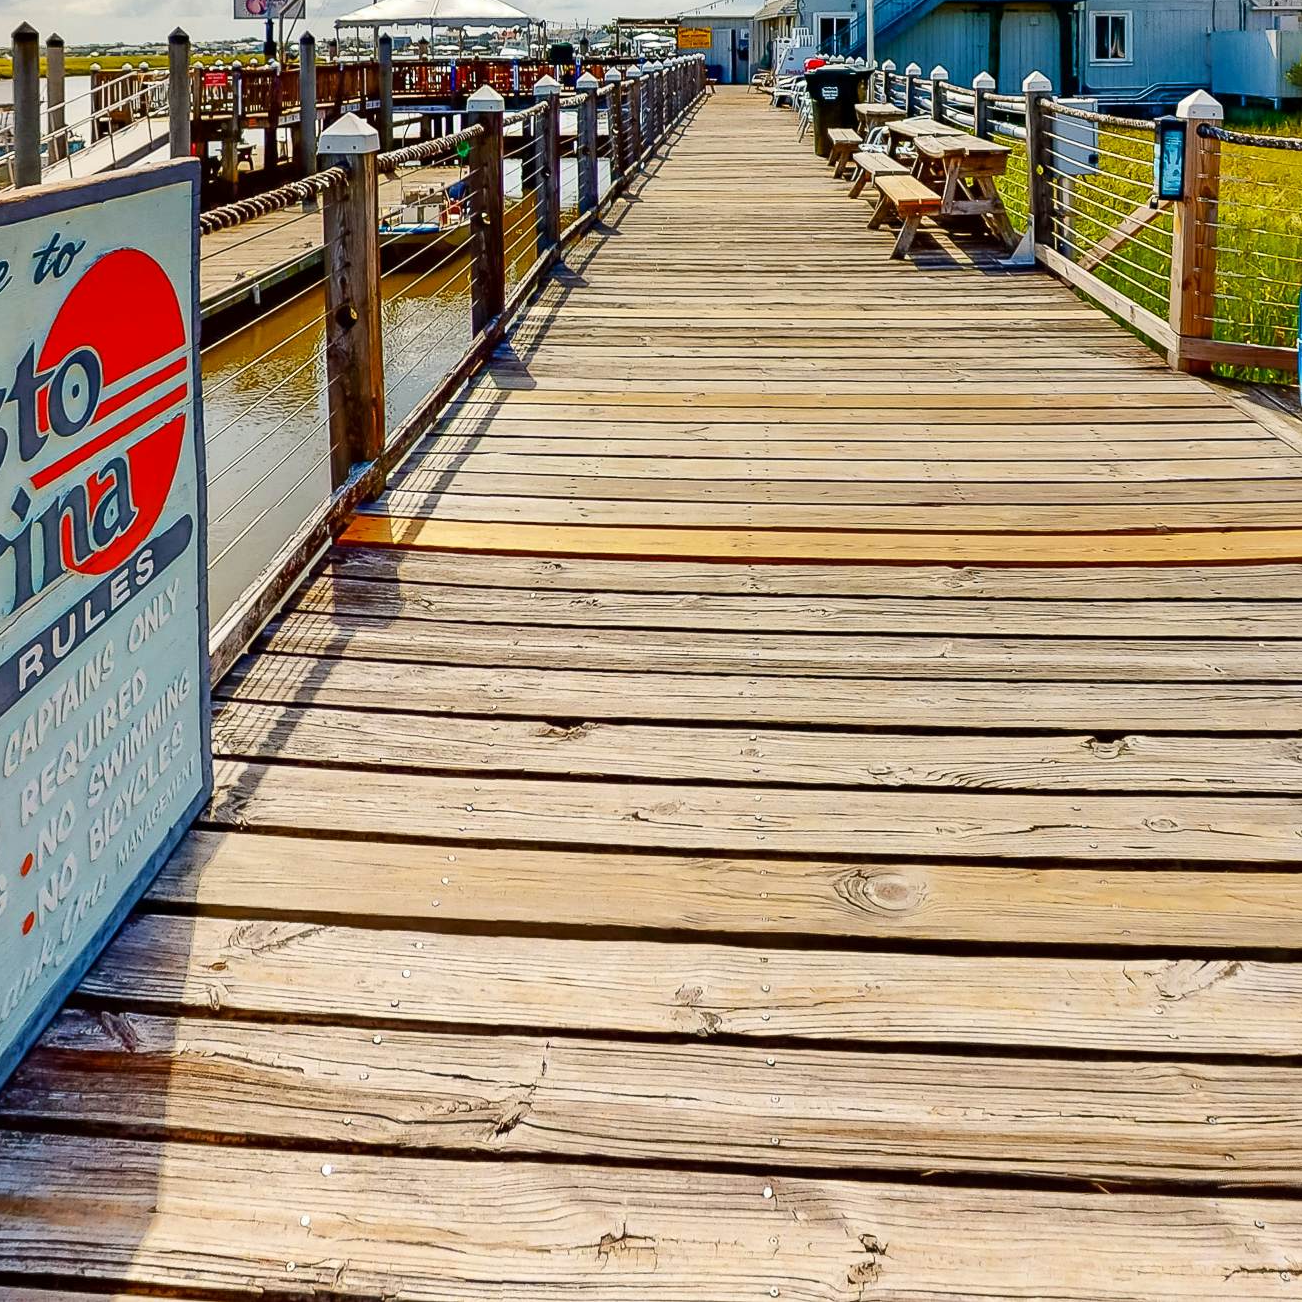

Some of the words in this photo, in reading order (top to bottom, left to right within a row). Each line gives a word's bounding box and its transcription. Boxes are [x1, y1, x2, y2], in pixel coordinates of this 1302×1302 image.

[33, 232, 86, 287] to
[2, 640, 115, 779] CAPTAINS
[127, 578, 180, 653] ONLY
[18, 547, 155, 692] RULES
[20, 667, 146, 826] REQUIRED
[36, 801, 76, 868] NO
[87, 666, 191, 809] SWIMMING
[38, 852, 77, 928] NO
[89, 720, 183, 863] BICYCLES
[117, 753, 196, 867] MANAGEMENT
